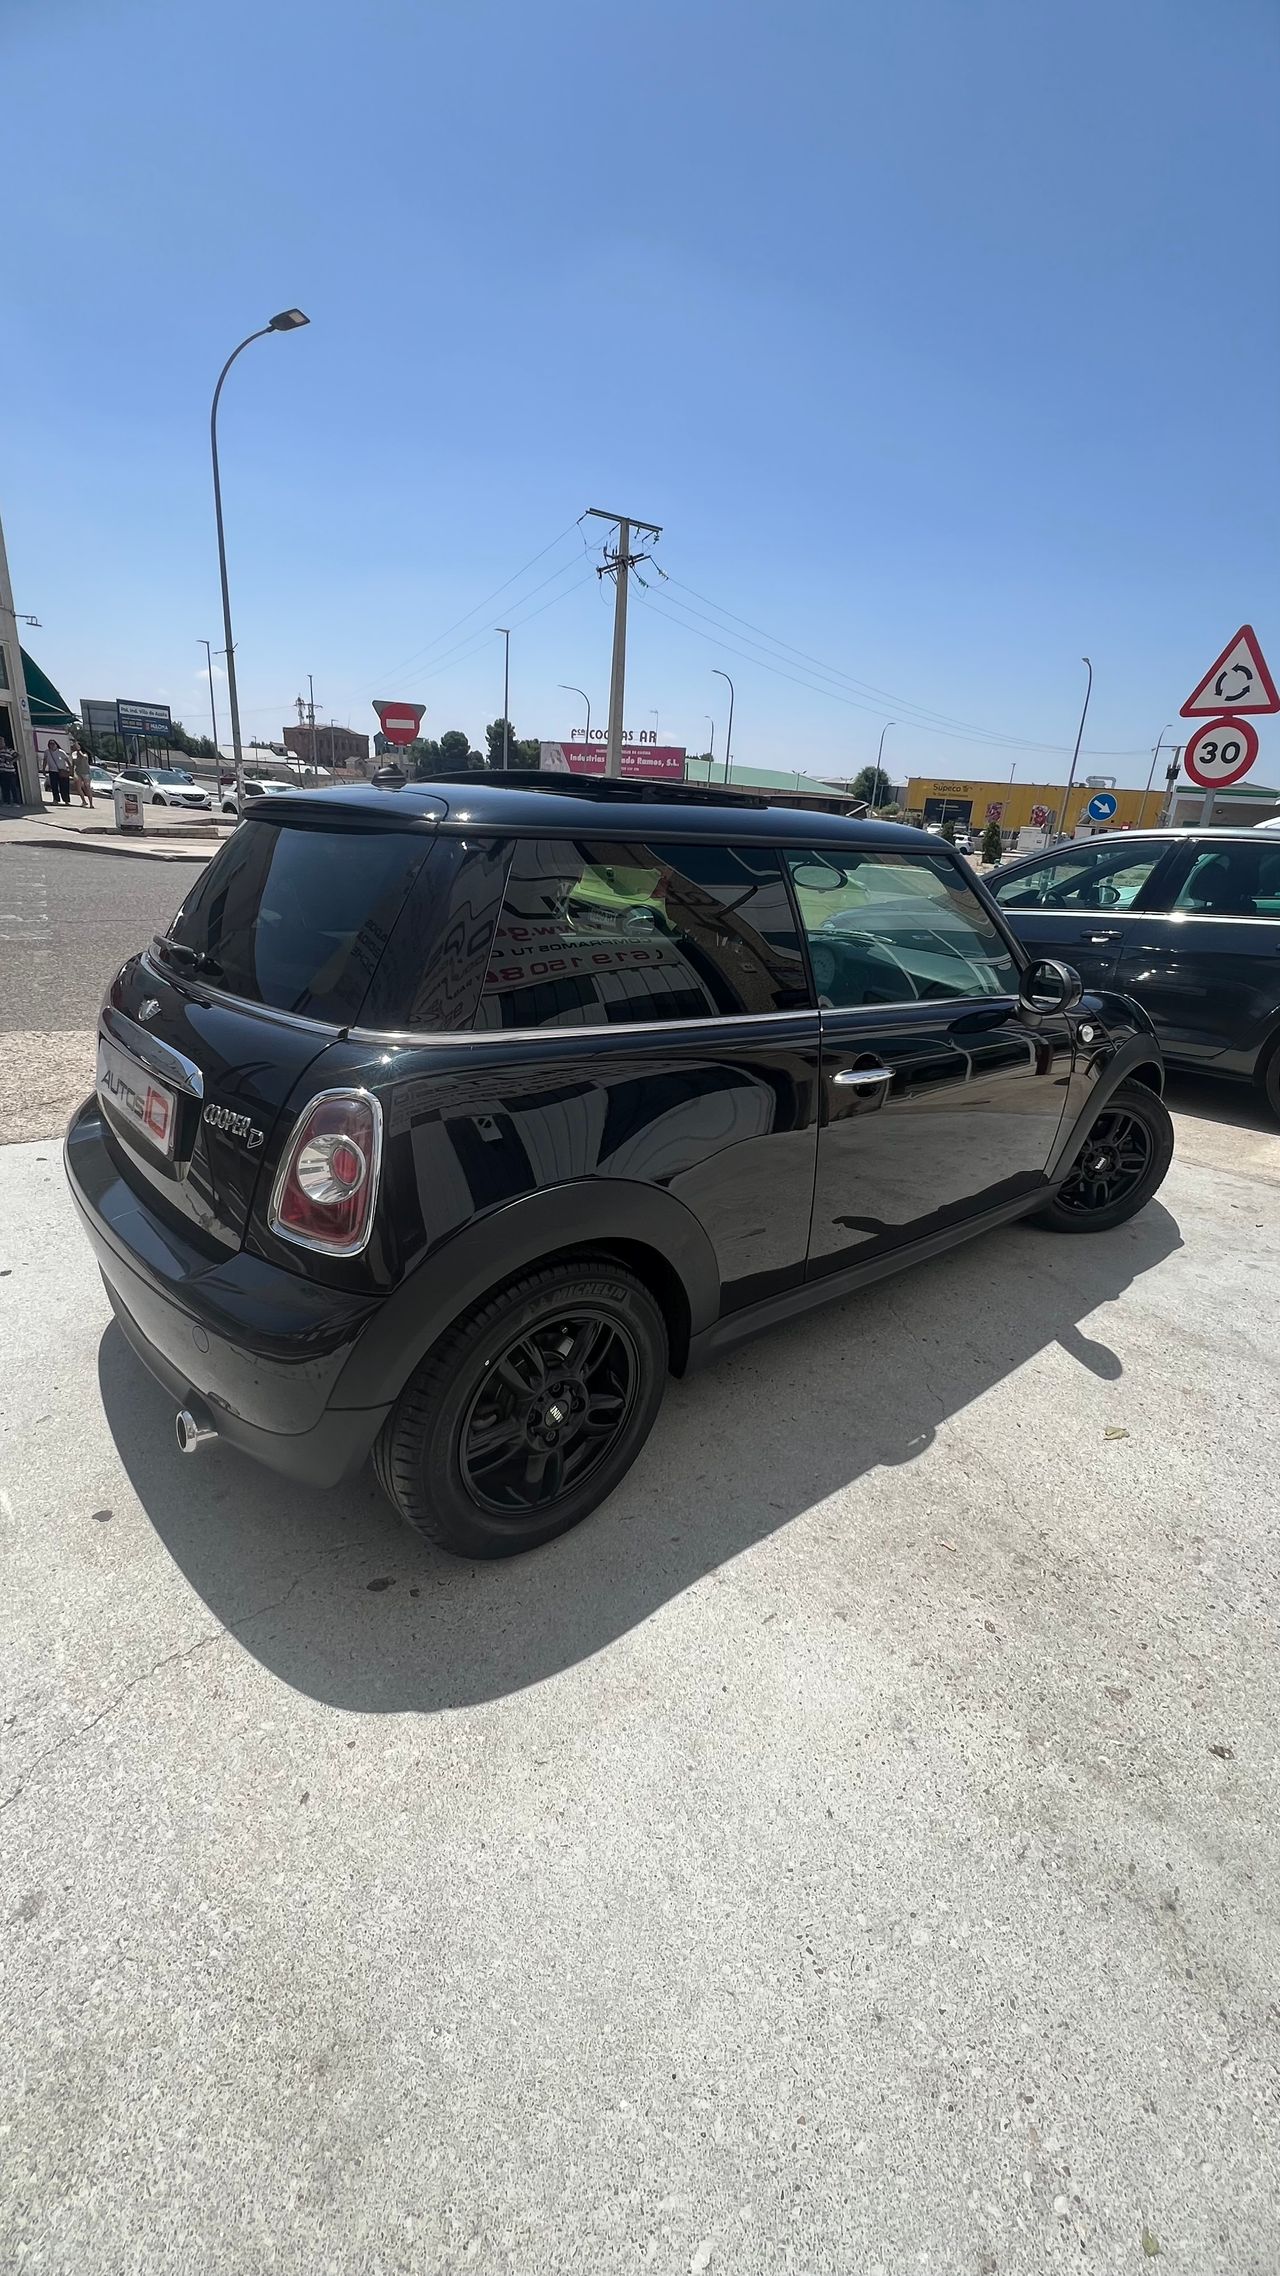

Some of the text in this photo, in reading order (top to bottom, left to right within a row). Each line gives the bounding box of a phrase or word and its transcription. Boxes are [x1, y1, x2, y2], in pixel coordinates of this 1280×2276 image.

[570, 753, 605, 763] Industrias
[1199, 741, 1241, 764] 30
[203, 1103, 264, 1149] COOPER D
